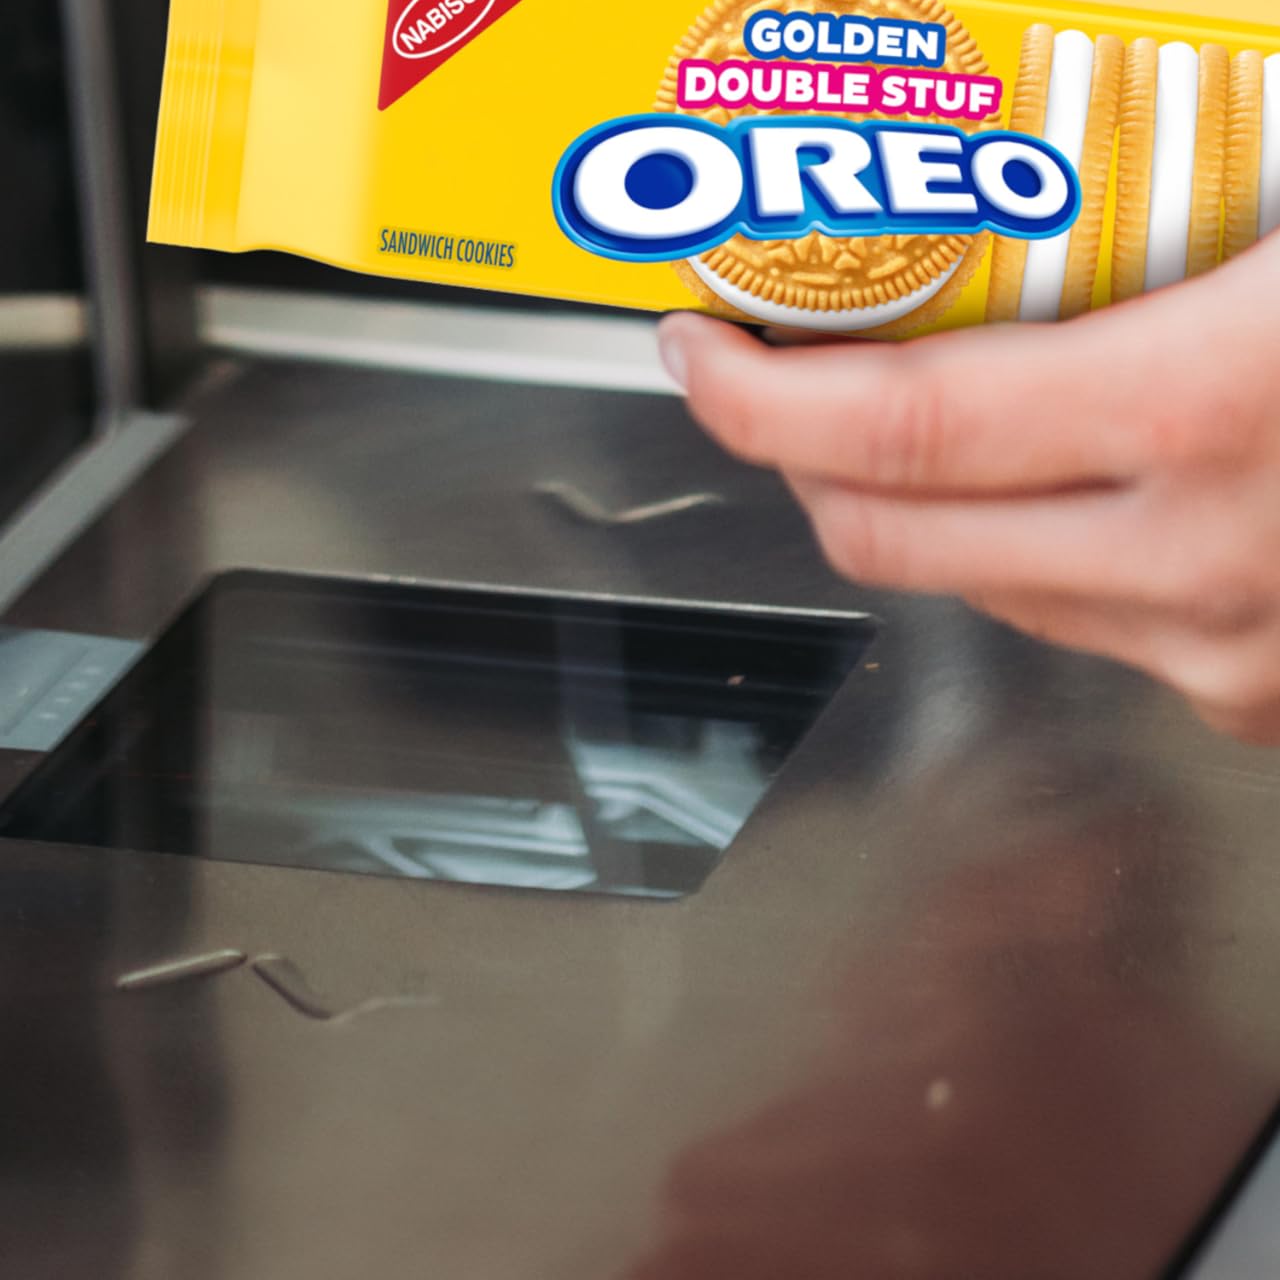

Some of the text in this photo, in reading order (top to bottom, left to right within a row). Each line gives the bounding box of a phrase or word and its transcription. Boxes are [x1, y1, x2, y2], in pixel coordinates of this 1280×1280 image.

[750, 19, 939, 60] GOLDEN
[683, 67, 996, 114] DOUBLE STUF
[572, 125, 1070, 240] OREO
[380, 228, 516, 268] SANDWICH COOKIES
